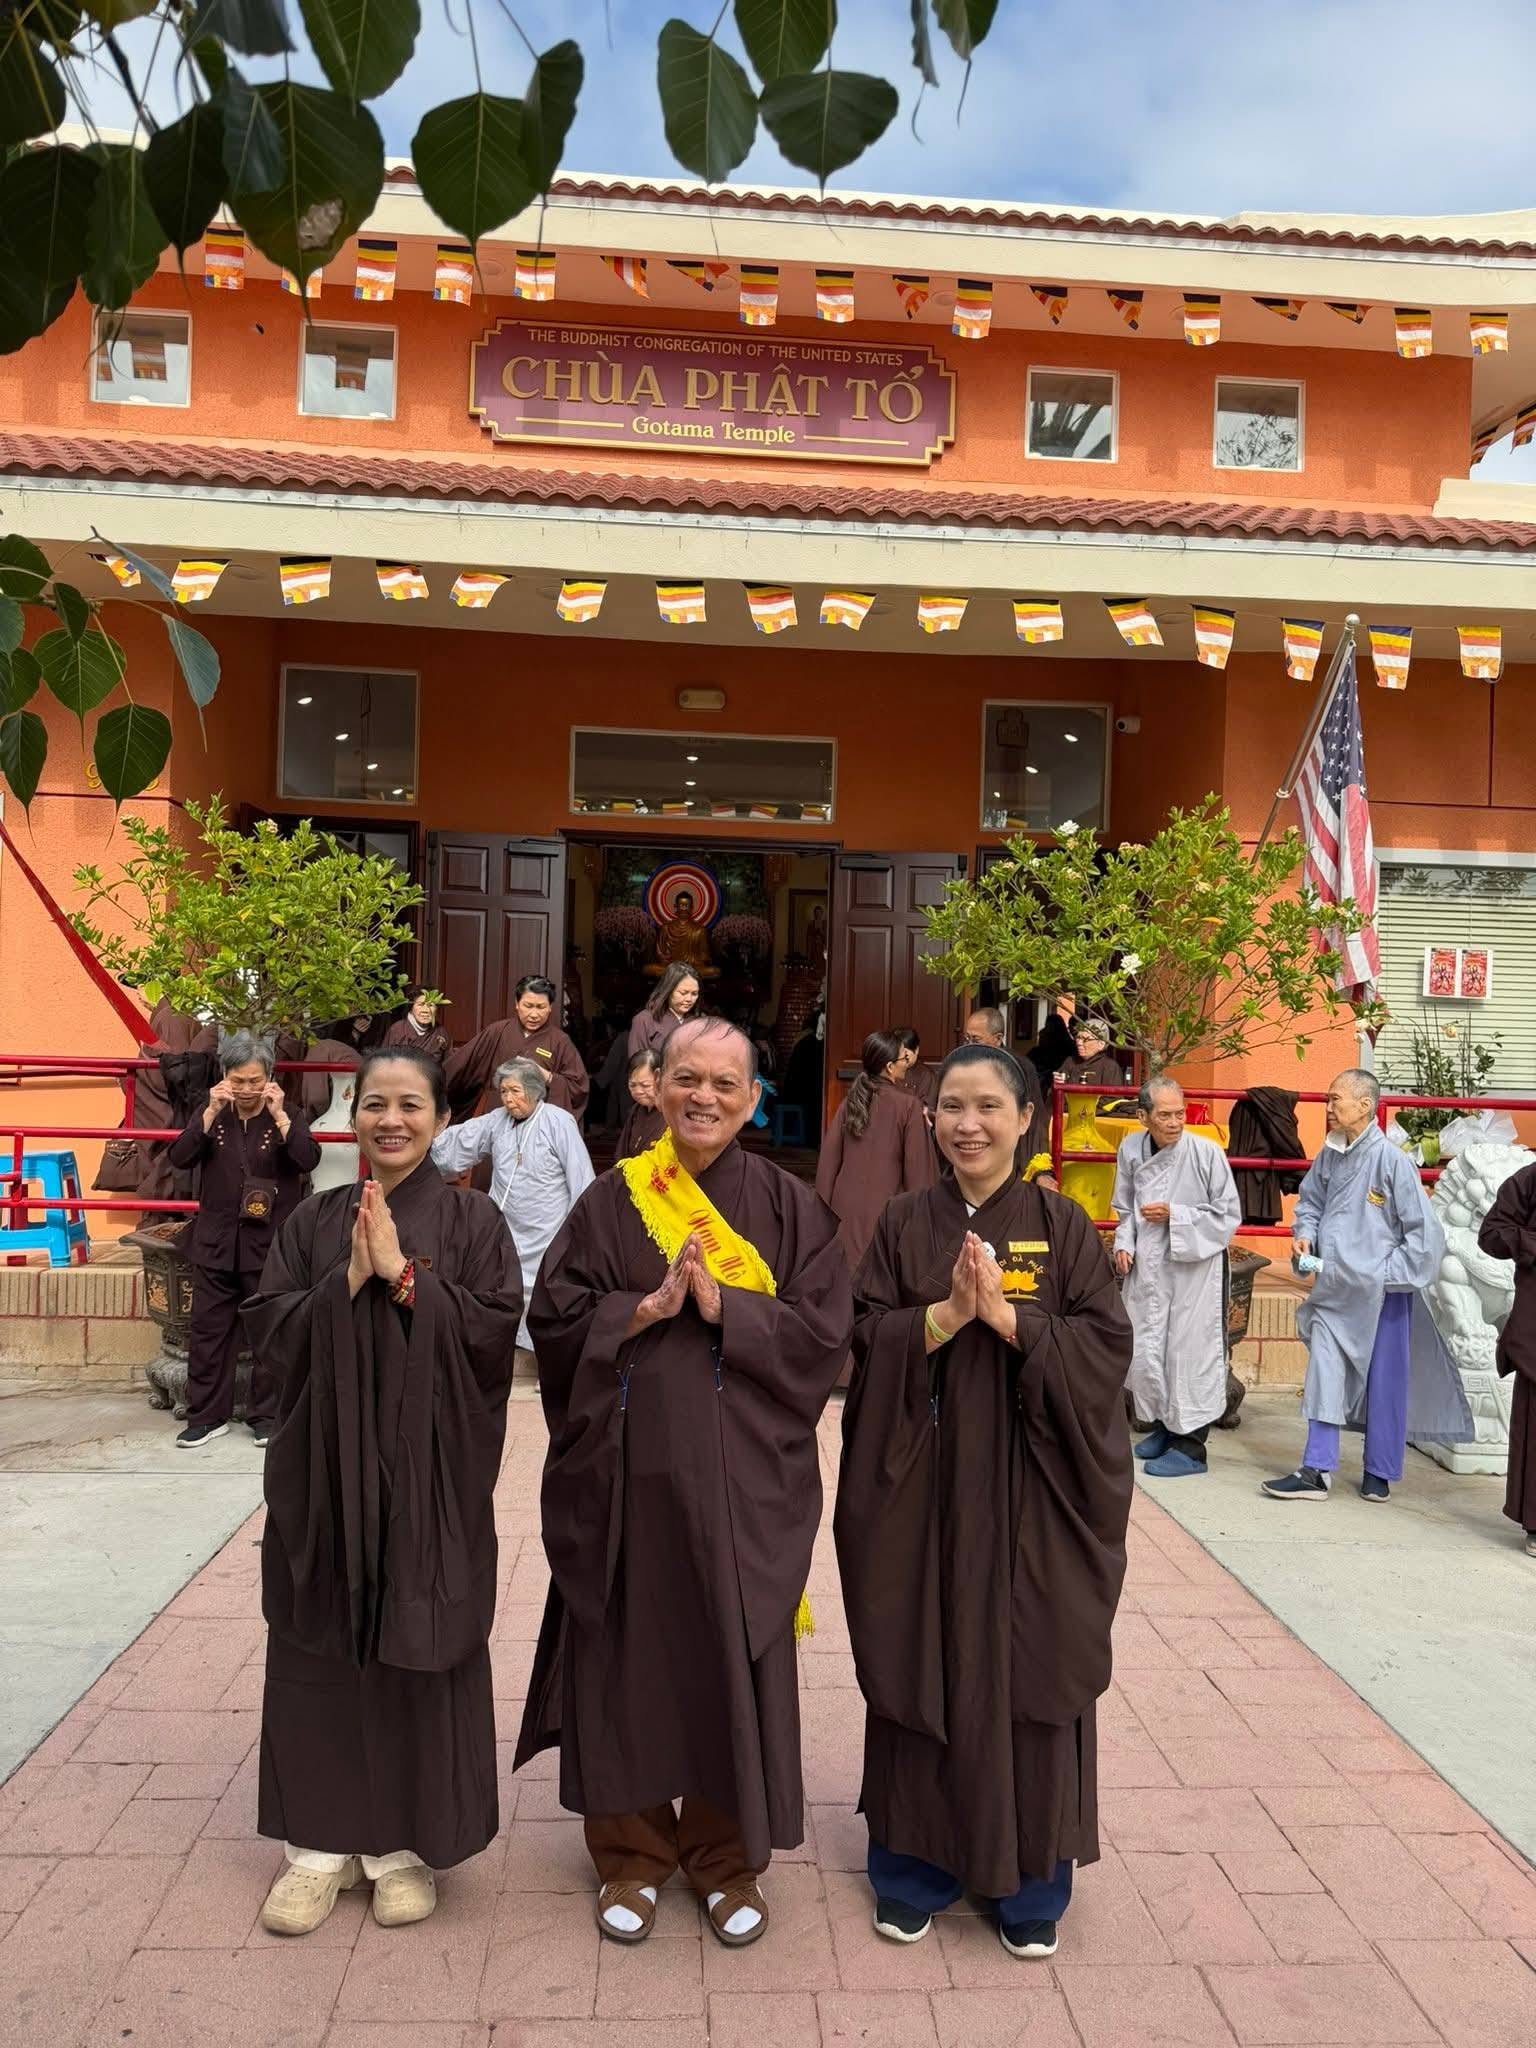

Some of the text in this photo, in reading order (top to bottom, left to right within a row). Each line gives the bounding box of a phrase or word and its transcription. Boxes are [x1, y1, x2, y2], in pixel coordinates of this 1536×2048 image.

[528, 328, 903, 366] THE BUDDHIST CONGREGATION OF THE UNITED STATES
[502, 351, 925, 424] CHÙA PHẬT TỔ
[632, 416, 795, 445] Gotama Temple
